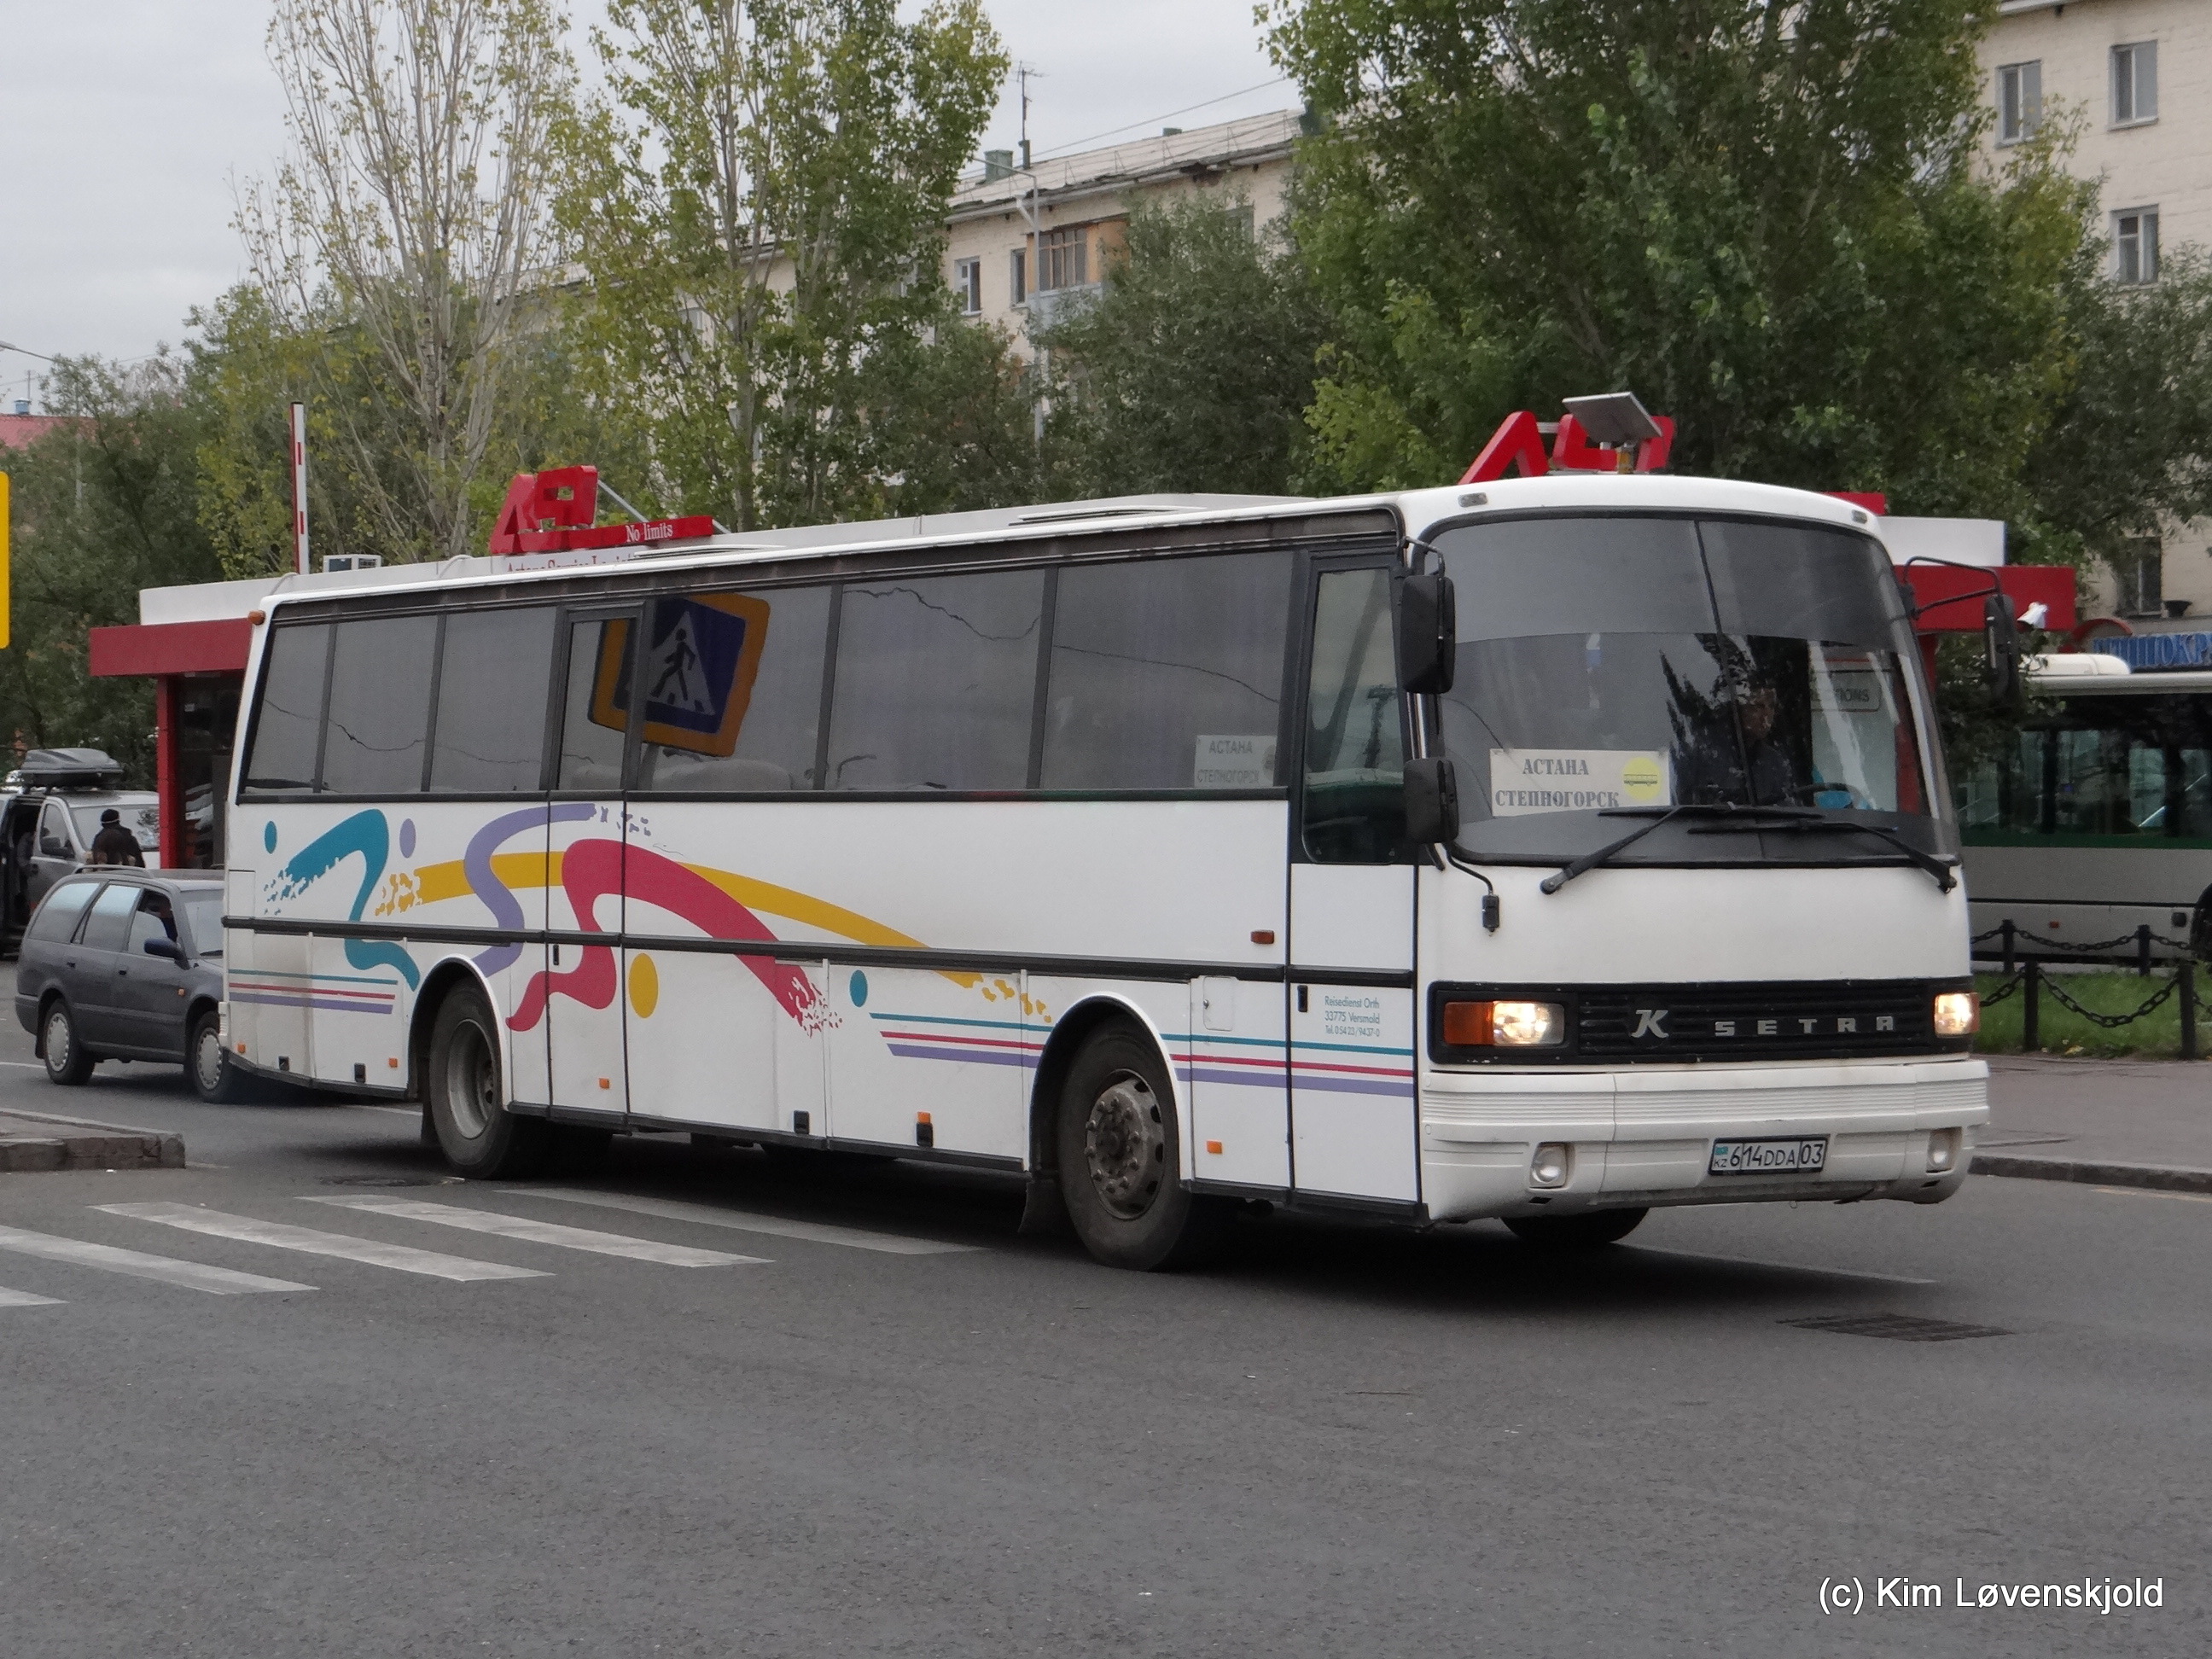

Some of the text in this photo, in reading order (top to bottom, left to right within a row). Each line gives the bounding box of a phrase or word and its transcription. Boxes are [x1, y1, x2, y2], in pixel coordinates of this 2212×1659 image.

[626, 521, 673, 543] No limits
[1208, 740, 1253, 754] АСТАНА
[1522, 758, 1589, 775] АСТАНА
[1494, 789, 1620, 808] СТЕПНОГОРСК
[1324, 995, 1380, 1009] Reisedienst Orth
[1324, 1010, 1380, 1024] 33775 Versmold
[1714, 1016, 1894, 1037] SETRA
[1714, 1158, 1727, 1168] KZ
